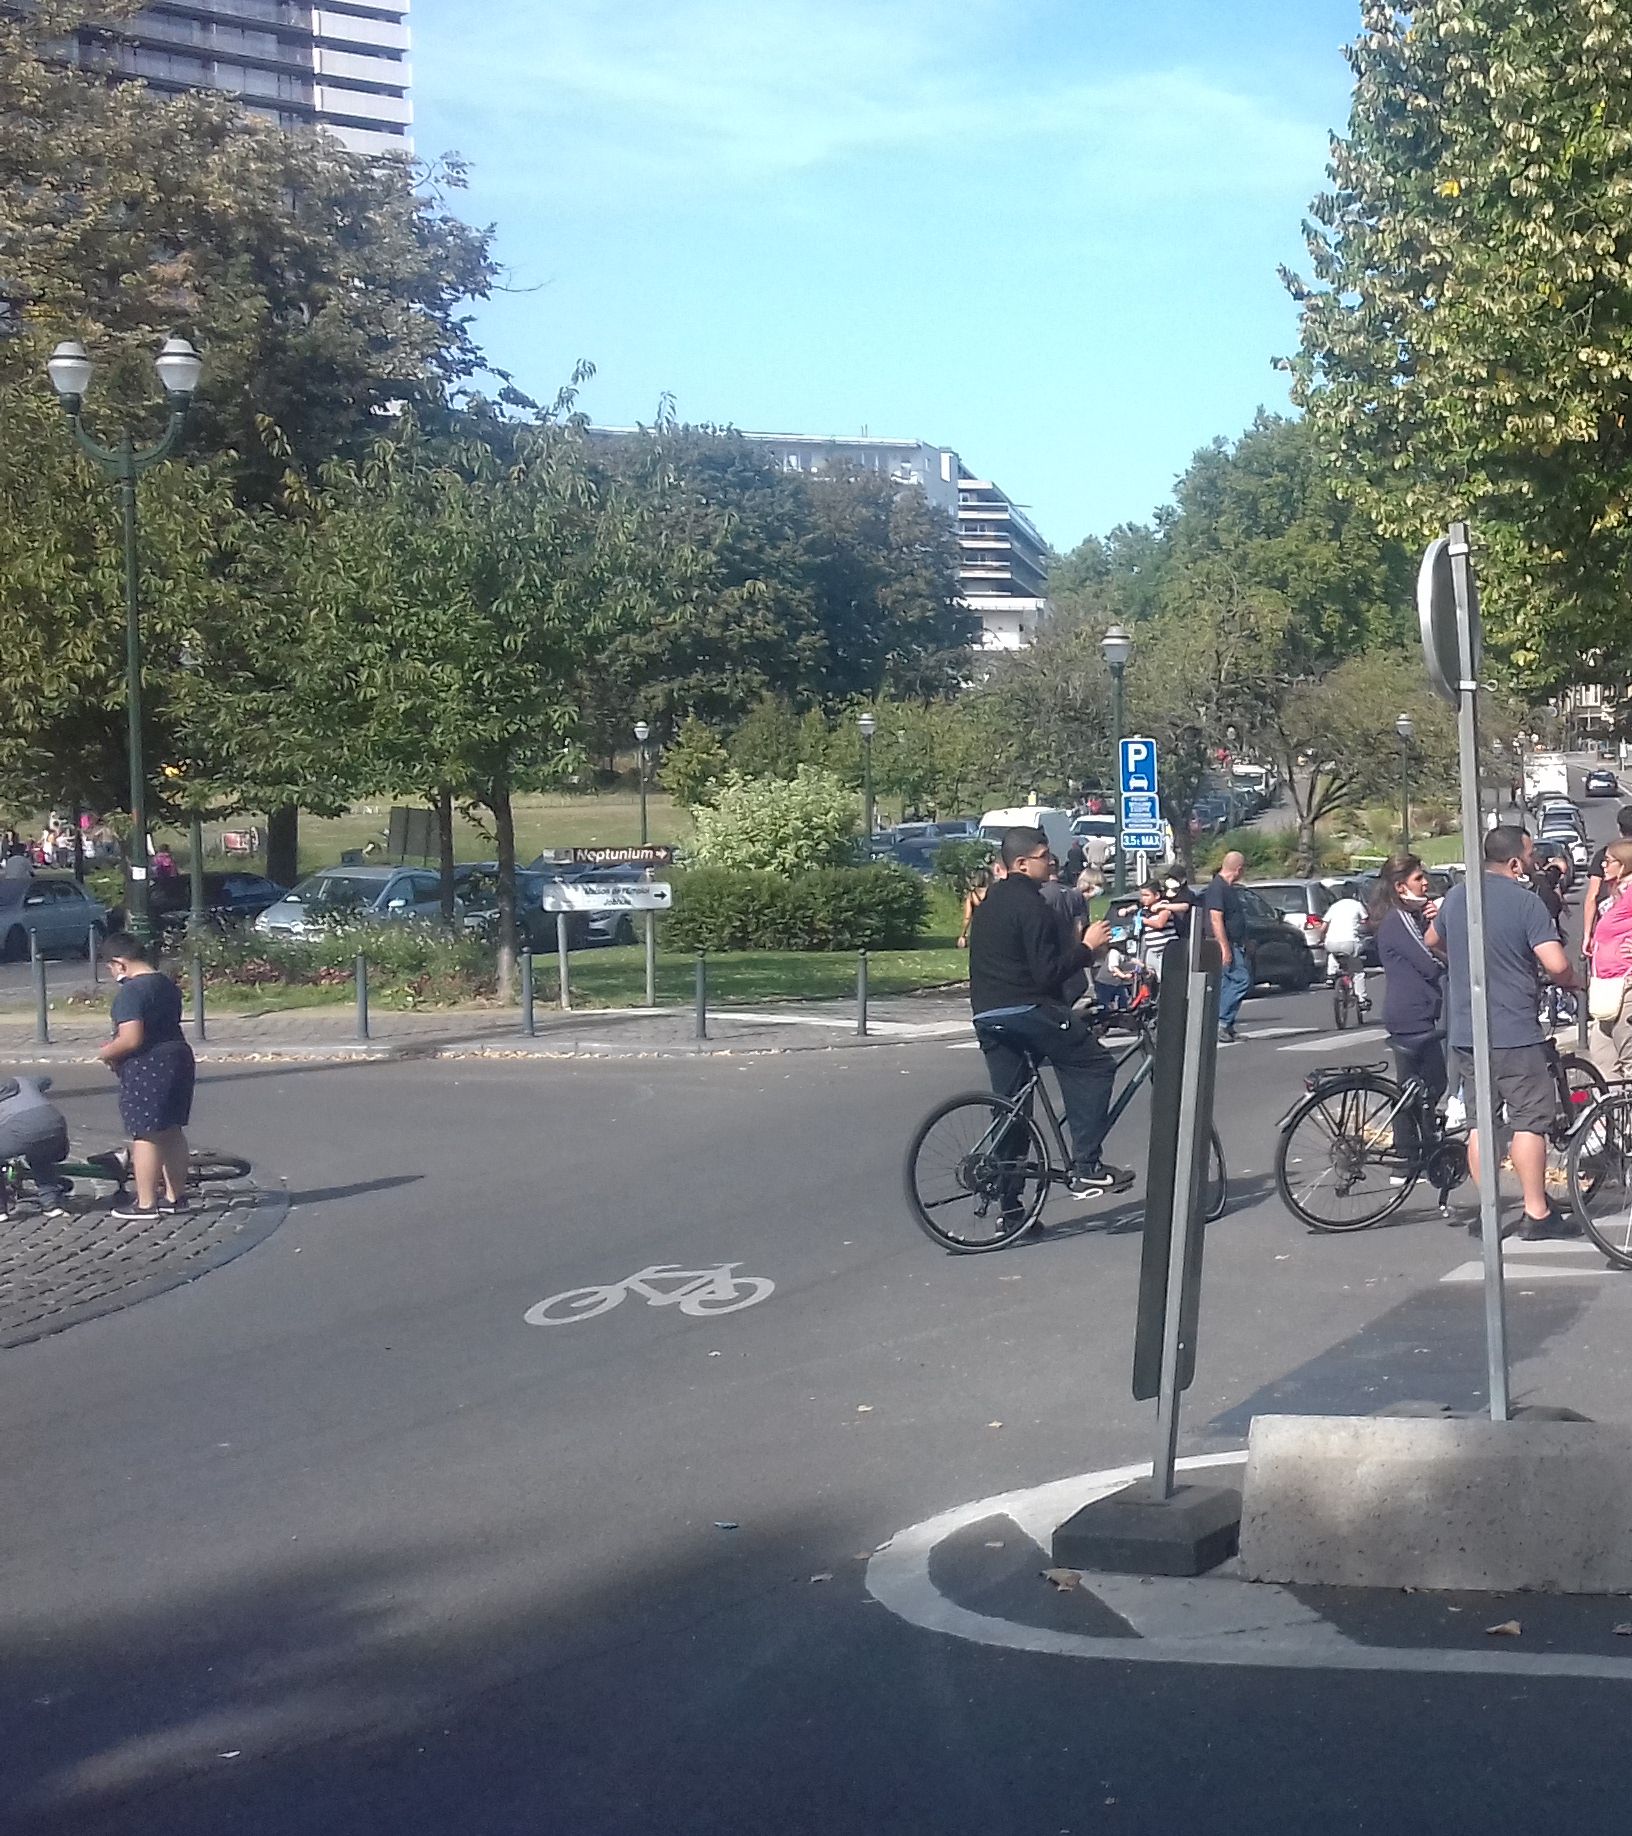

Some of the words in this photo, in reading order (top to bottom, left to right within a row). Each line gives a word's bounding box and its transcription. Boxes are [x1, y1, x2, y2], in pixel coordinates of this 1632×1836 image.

[1127, 743, 1148, 773] P
[1141, 835, 1161, 846] MAX
[575, 847, 654, 862] Neptunium
